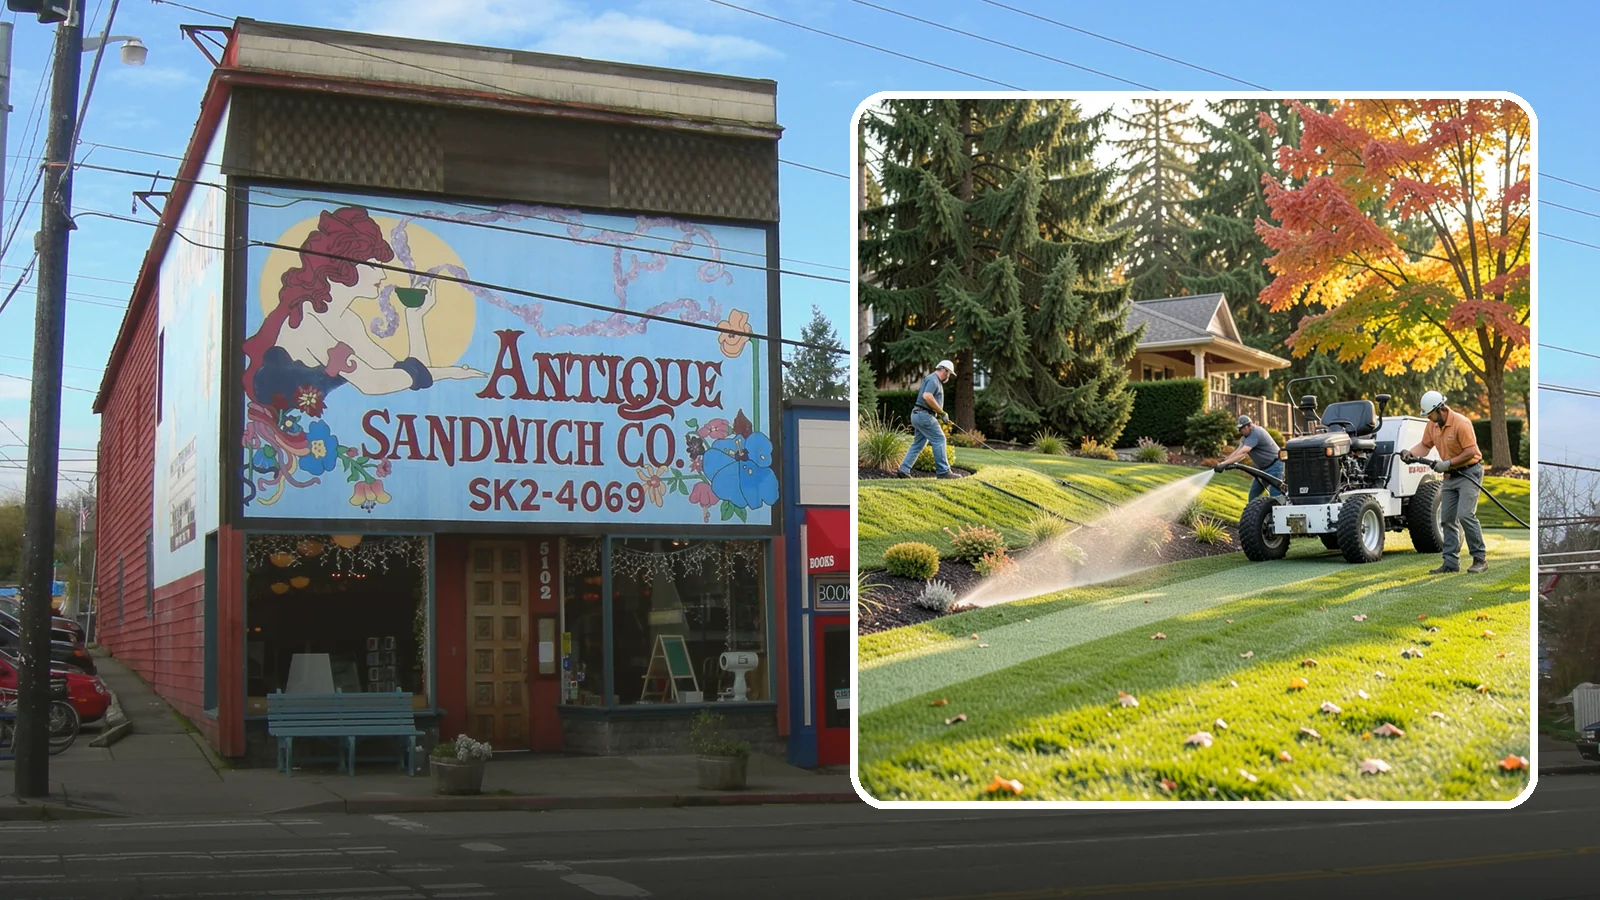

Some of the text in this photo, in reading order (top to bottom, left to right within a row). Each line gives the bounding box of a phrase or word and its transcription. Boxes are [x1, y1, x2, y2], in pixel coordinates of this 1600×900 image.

[476, 329, 724, 420] ANTIQUE
[361, 408, 685, 469] SANDWICH CO.
[468, 477, 646, 513] SK2-4069
[809, 555, 835, 568] BOOKS
